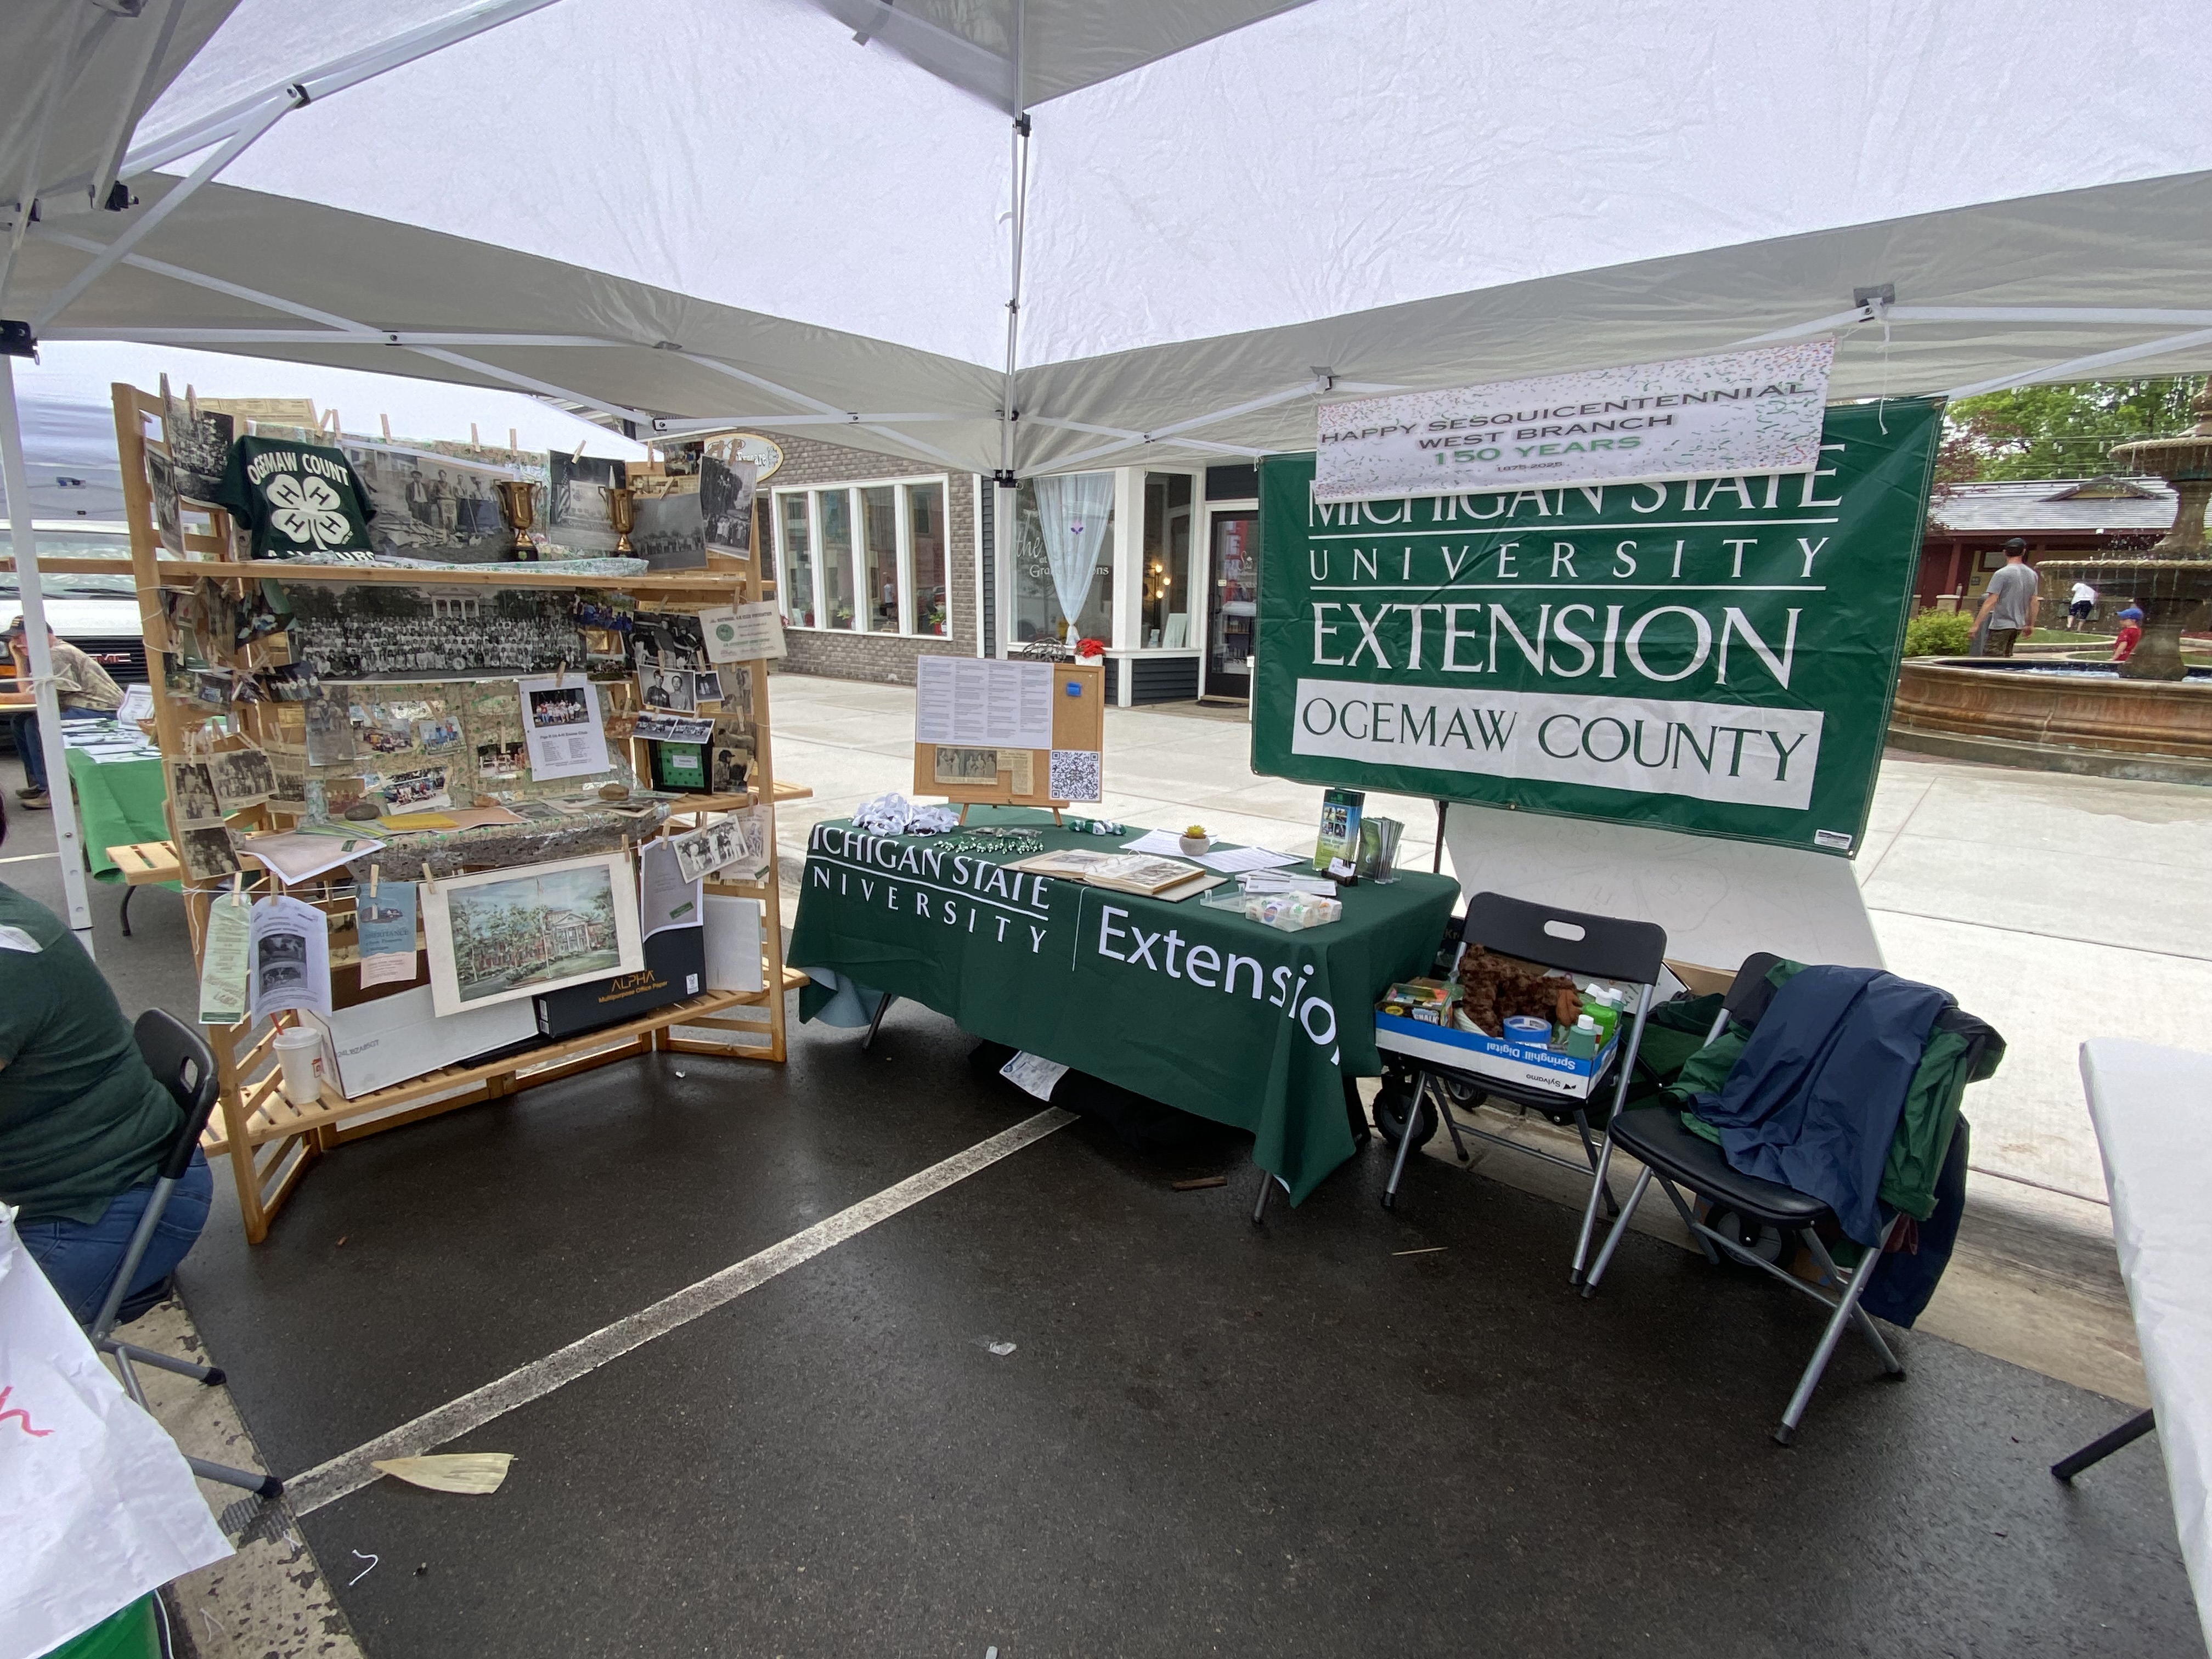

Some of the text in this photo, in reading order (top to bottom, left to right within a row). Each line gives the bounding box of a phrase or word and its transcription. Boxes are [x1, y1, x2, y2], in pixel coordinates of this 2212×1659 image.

[1321, 384, 1815, 443] HAPPY SESQUICENTENNIAL
[1419, 414, 1673, 449] WEST BRANCH
[1435, 436, 1641, 465] 150 YEARS
[247, 452, 298, 485] OGEMAW
[1310, 537, 1830, 580] UNIVERSITY
[1311, 602, 1804, 690] EXTENSION
[1302, 697, 1810, 782] OGEMAW COUNTY
[952, 855, 1054, 910] STATE
[611, 970, 655, 992] ALPHA
[1098, 905, 1340, 1066] Extensio
[1415, 1014, 1439, 1024] CHALK
[1486, 1042, 1576, 1070] Springhill Digital
[1526, 1074, 1561, 1087] Sylvamo
